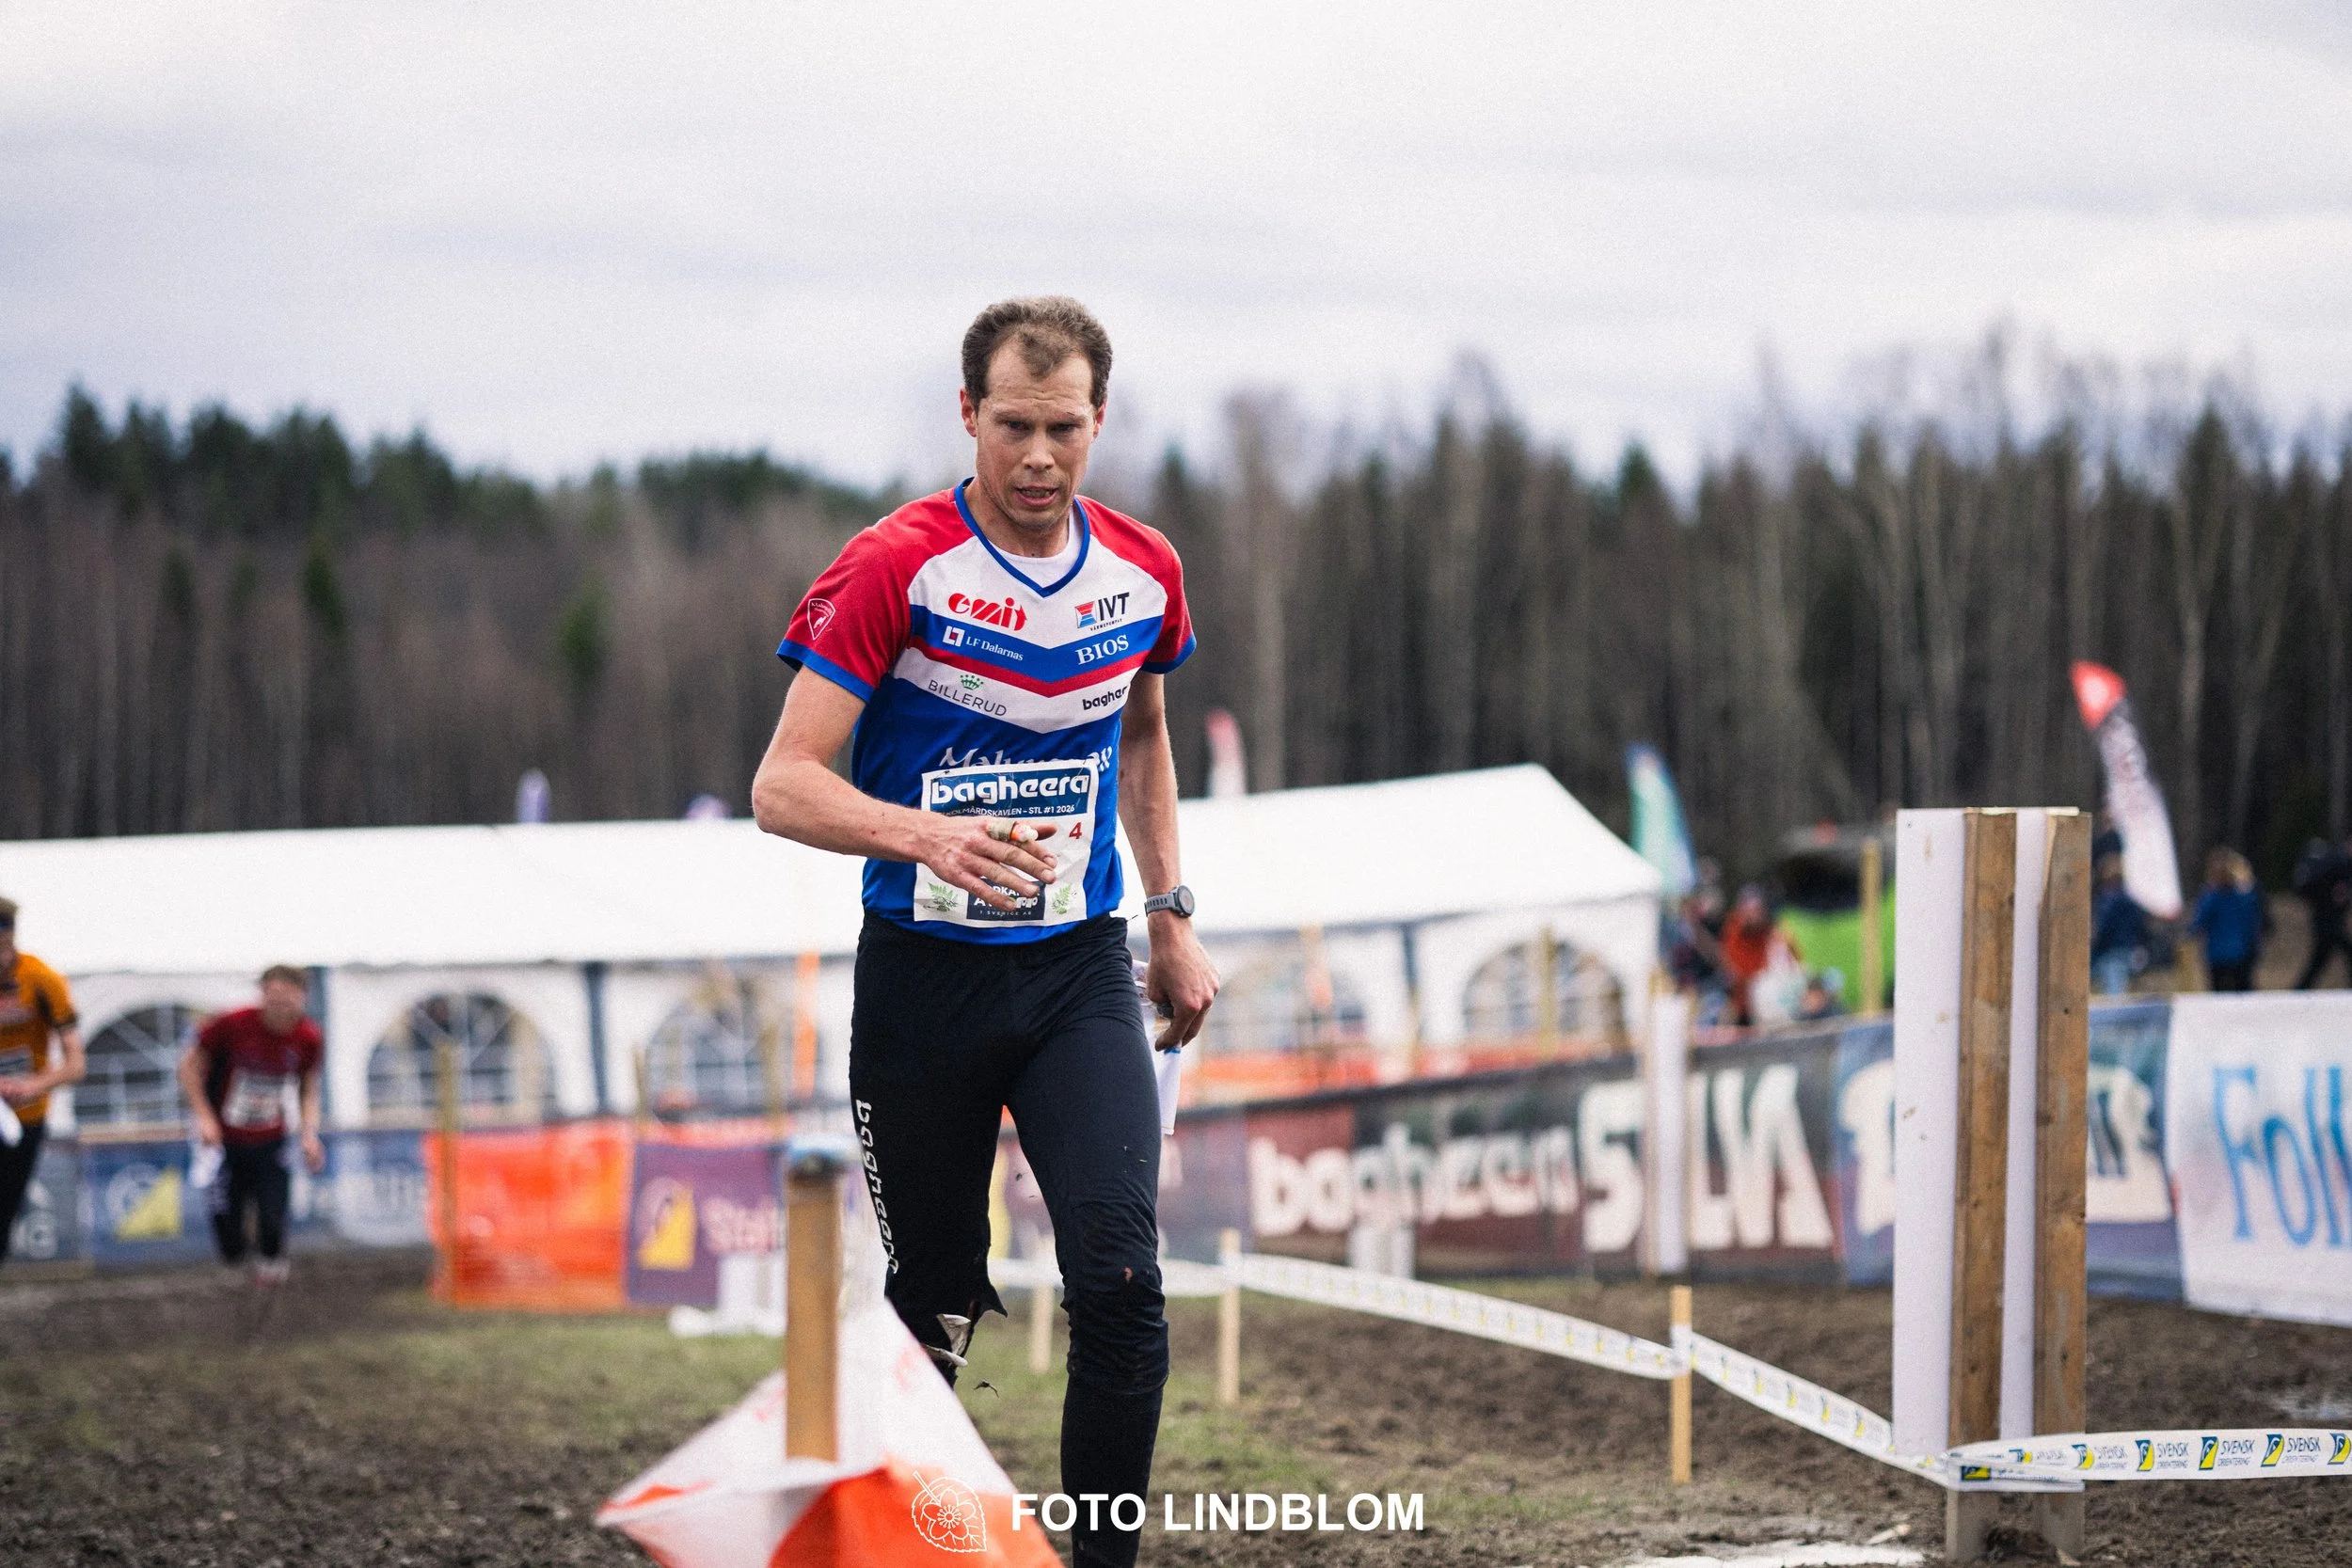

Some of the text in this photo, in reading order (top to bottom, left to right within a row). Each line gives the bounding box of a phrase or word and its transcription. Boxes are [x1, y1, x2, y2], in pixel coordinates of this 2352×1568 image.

[947, 593, 1027, 631] emit
[1098, 592, 1130, 621] IVT
[966, 636, 1024, 661] LF Dalarnas
[1074, 634, 1129, 665] BIOS
[928, 679, 1008, 717] BILLERUD
[931, 774, 1090, 805] bagheera
[1028, 806, 1042, 815] STL
[1043, 805, 1054, 814] #1
[1056, 804, 1075, 814] 2026
[1069, 821, 1082, 839] 4
[1578, 1063, 1835, 1253] SLVA
[2156, 1442, 2189, 1458] SVENSK
[2219, 1440, 2255, 1455] SVENSK
[2286, 1436, 2322, 1453] SVENSK
